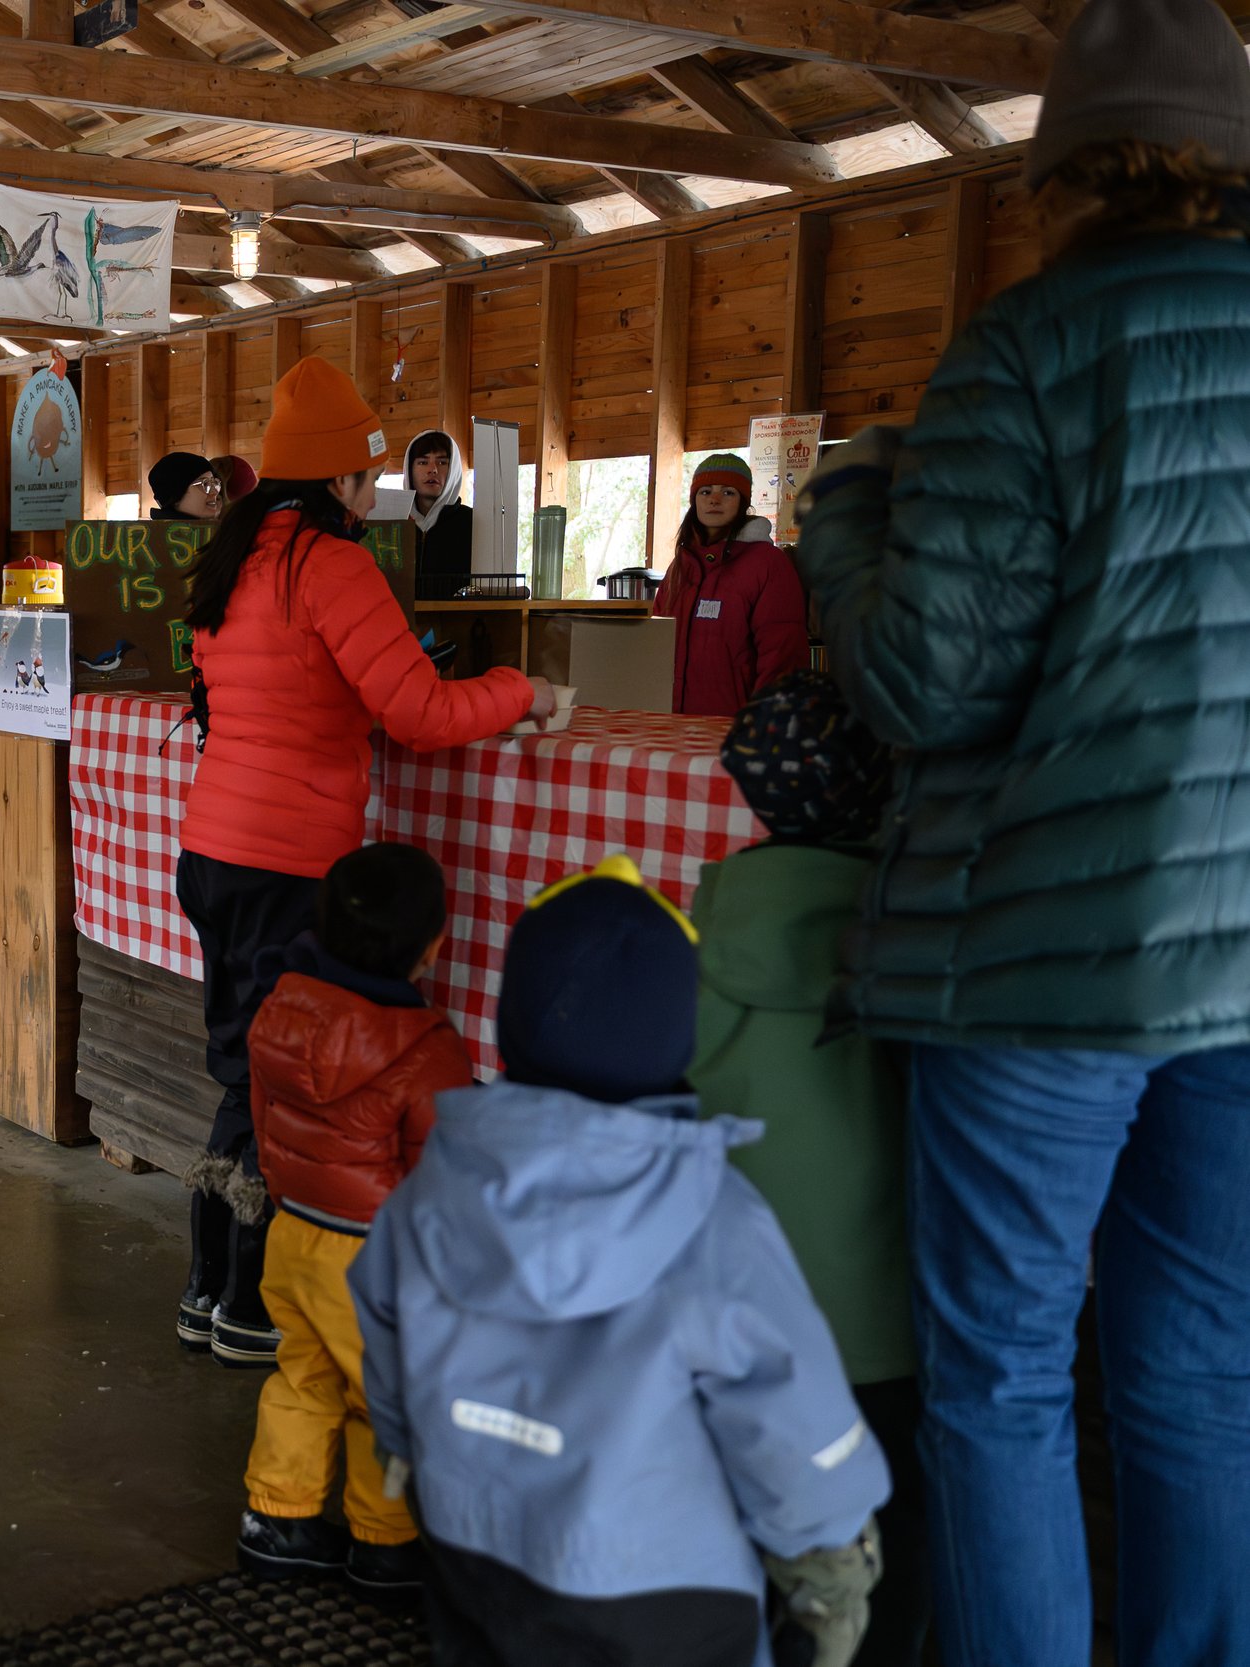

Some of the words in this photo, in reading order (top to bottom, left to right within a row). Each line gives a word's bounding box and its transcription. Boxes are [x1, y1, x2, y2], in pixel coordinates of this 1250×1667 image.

[17, 401, 29, 435] MAKE
[29, 392, 35, 402] A
[35, 378, 65, 397] PANCAKE
[64, 395, 77, 432] HAPPY
[781, 430, 792, 438] AND
[70, 523, 160, 569] OUR
[121, 575, 165, 611] IS
[1, 699, 15, 711] Enjoy
[19, 703, 33, 712] sweet
[33, 704, 50, 715] maple
[50, 706, 67, 716] treat!
